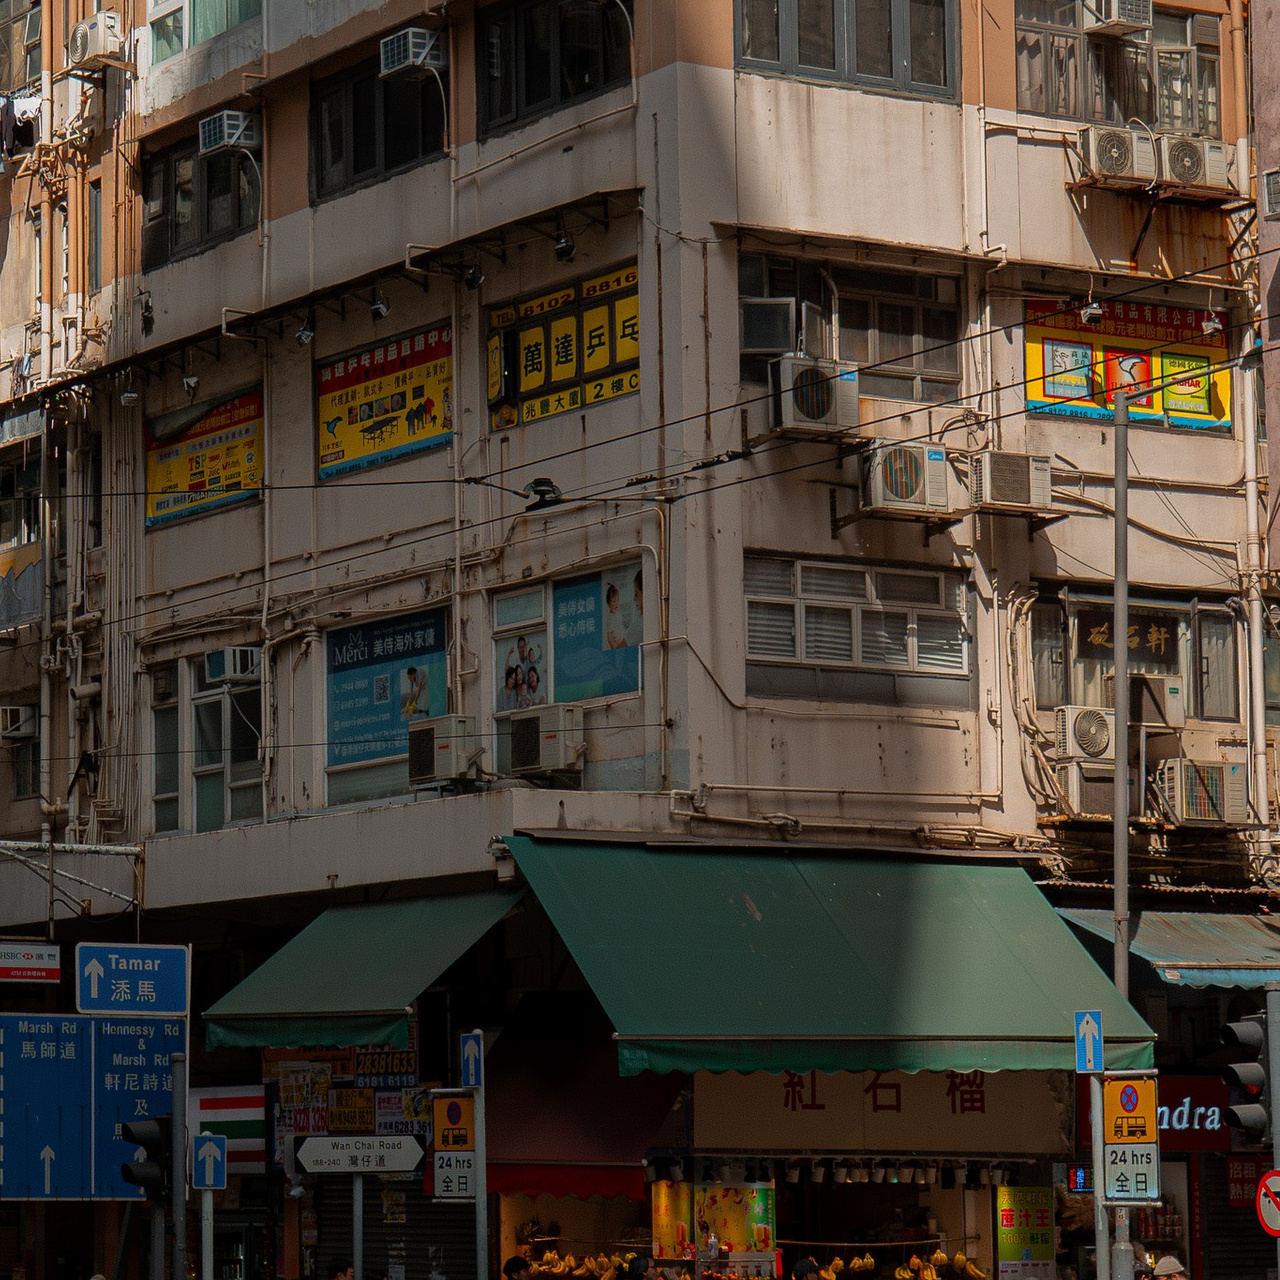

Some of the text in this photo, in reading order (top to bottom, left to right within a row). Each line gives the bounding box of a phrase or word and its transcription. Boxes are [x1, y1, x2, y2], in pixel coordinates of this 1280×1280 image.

[523, 294, 571, 316] 8102
[586, 272, 637, 296] 8816
[523, 315, 639, 376] 萬達乒乓
[335, 641, 369, 665] Merci
[0, 951, 21, 960] HSBC
[108, 954, 161, 970] Tamar
[110, 979, 157, 1003] 添馬
[19, 1021, 77, 1034] Marsh Rd
[102, 1022, 179, 1038] Hennessy Rd
[21, 1041, 77, 1060] 馬師道
[137, 1039, 146, 1050] &
[113, 1054, 169, 1066] Marsh Rd
[358, 1053, 415, 1075] 28381633
[357, 1074, 416, 1087] 6181 6119
[134, 1098, 149, 1116] 及
[394, 1121, 414, 1134] 6283
[331, 1140, 402, 1150] Wan Chai Road
[348, 1154, 386, 1168] 灣仔道
[438, 1156, 472, 1169] 24 hrs
[1110, 1150, 1151, 1165] 24 hrs
[442, 1175, 468, 1192] 全日
[1116, 1171, 1147, 1193] 全日
[1000, 1207, 1050, 1229] 蔗汁王
